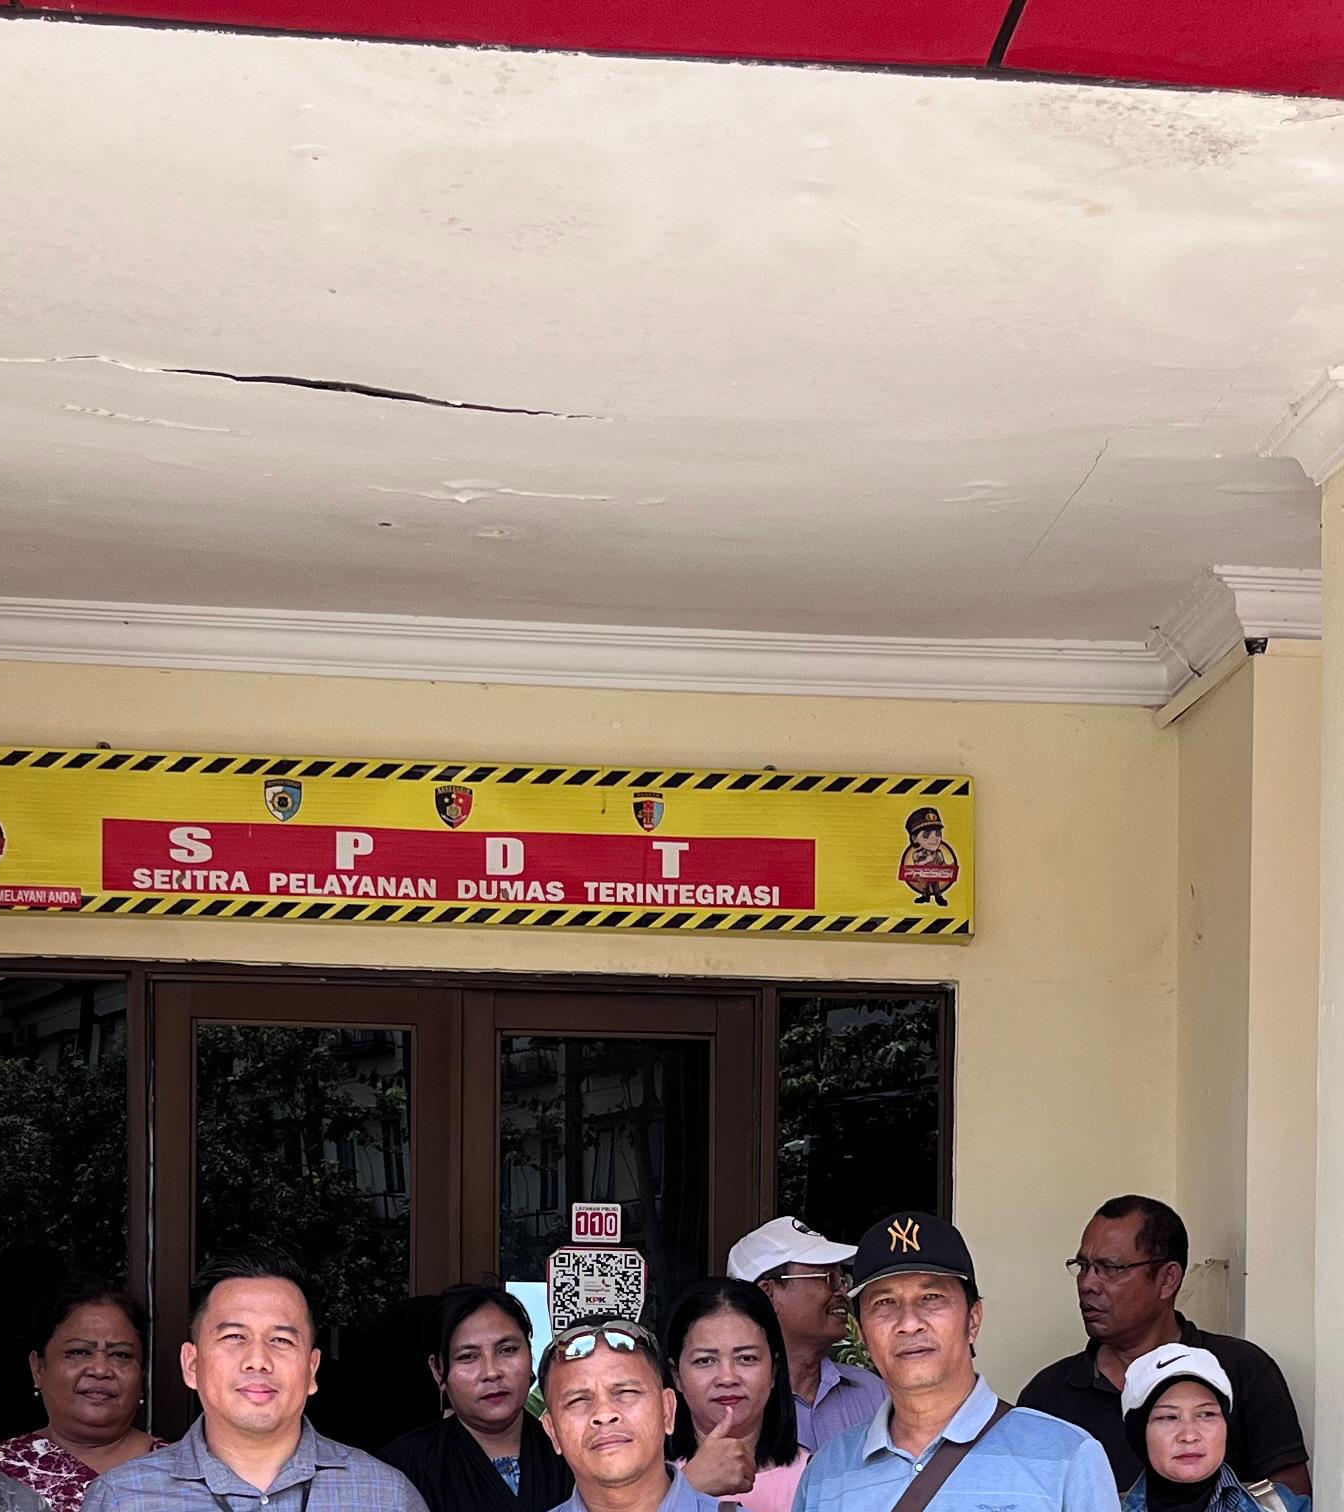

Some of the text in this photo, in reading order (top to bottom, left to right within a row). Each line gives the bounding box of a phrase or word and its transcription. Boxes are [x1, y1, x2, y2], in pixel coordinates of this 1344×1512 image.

[169, 826, 690, 879] S P D T
[904, 867, 954, 878] PRESISI
[48, 891, 77, 904] ANDA
[132, 868, 780, 906] SENTRA PELAYANAN DUMAS TERINTEGRASI
[576, 1214, 617, 1234] 110
[887, 1217, 921, 1253] NY
